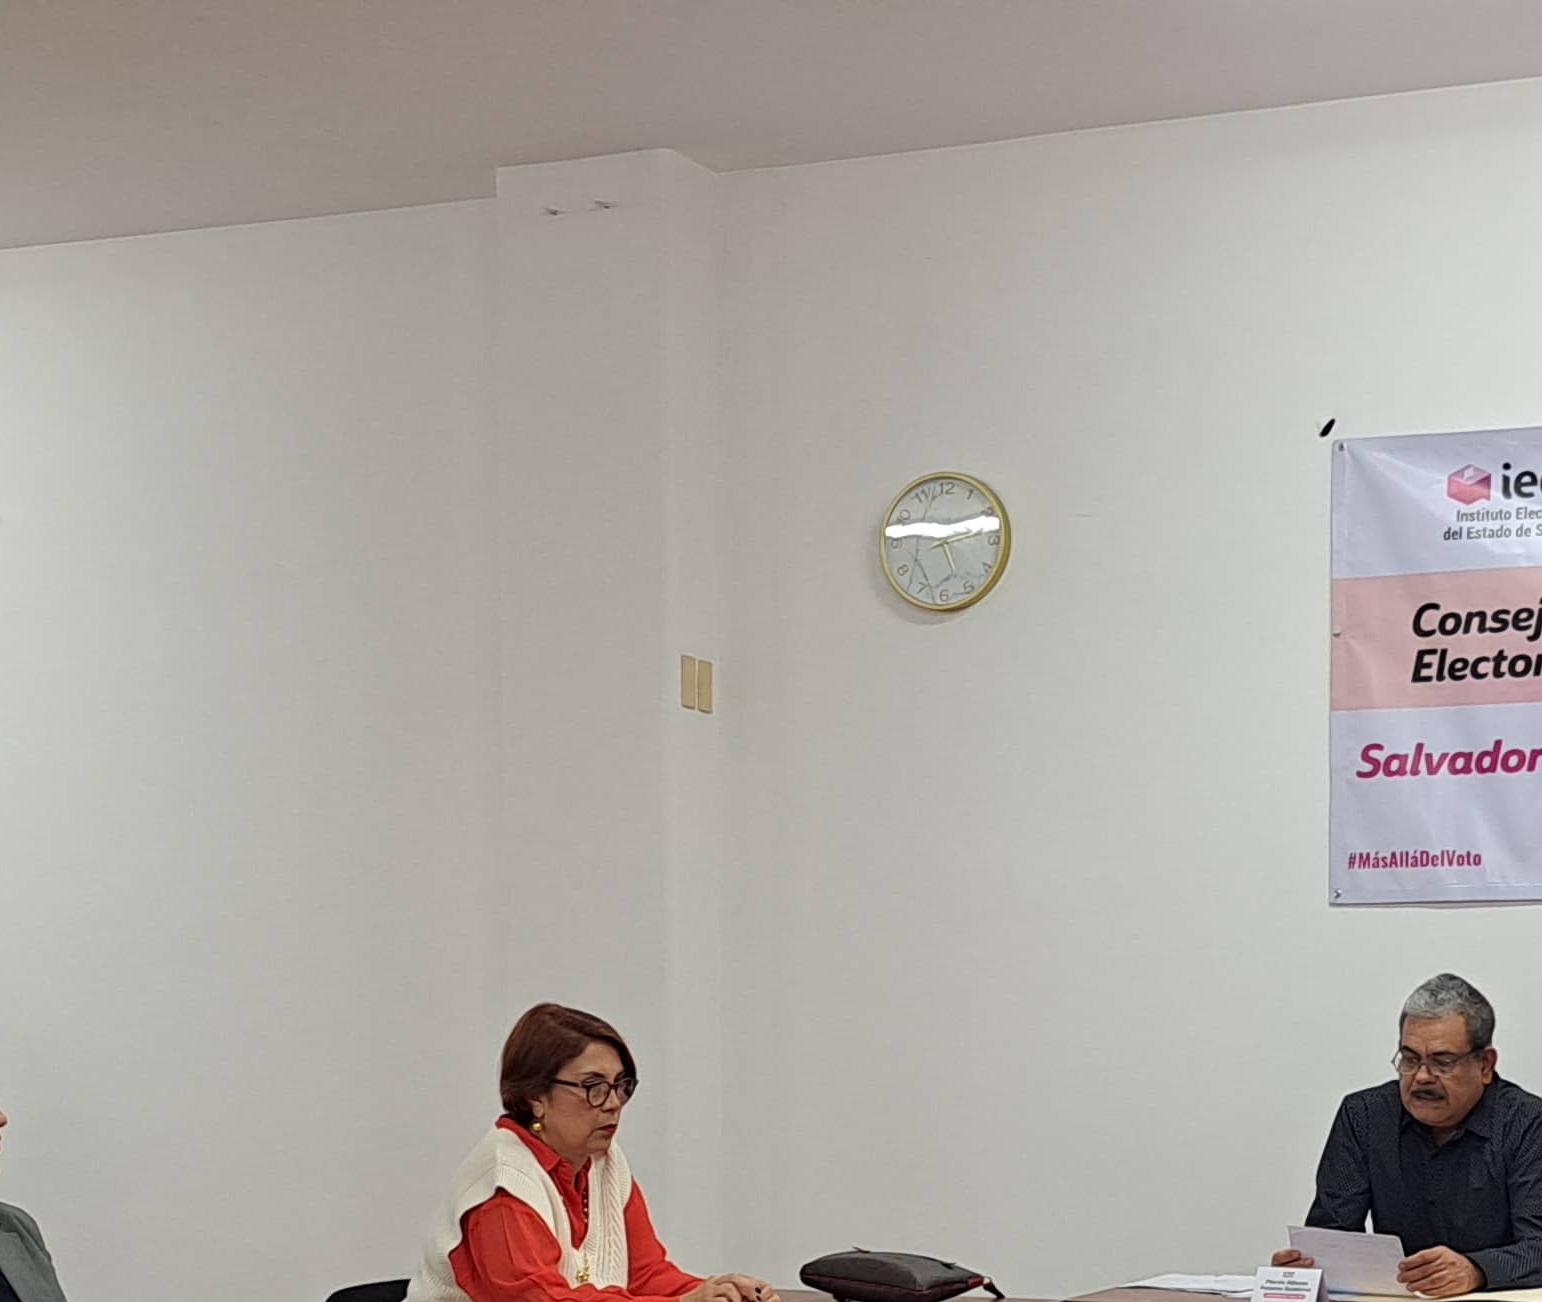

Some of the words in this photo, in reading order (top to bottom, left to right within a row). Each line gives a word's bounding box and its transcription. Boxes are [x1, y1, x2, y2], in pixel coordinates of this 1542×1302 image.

[939, 481, 956, 495] 12
[1456, 509, 1510, 523] Instituto
[1443, 526, 1463, 541] del
[1466, 525, 1511, 539] Estado
[1515, 524, 1532, 538] de
[1347, 850, 1482, 870] #MásAlláDelVoto
